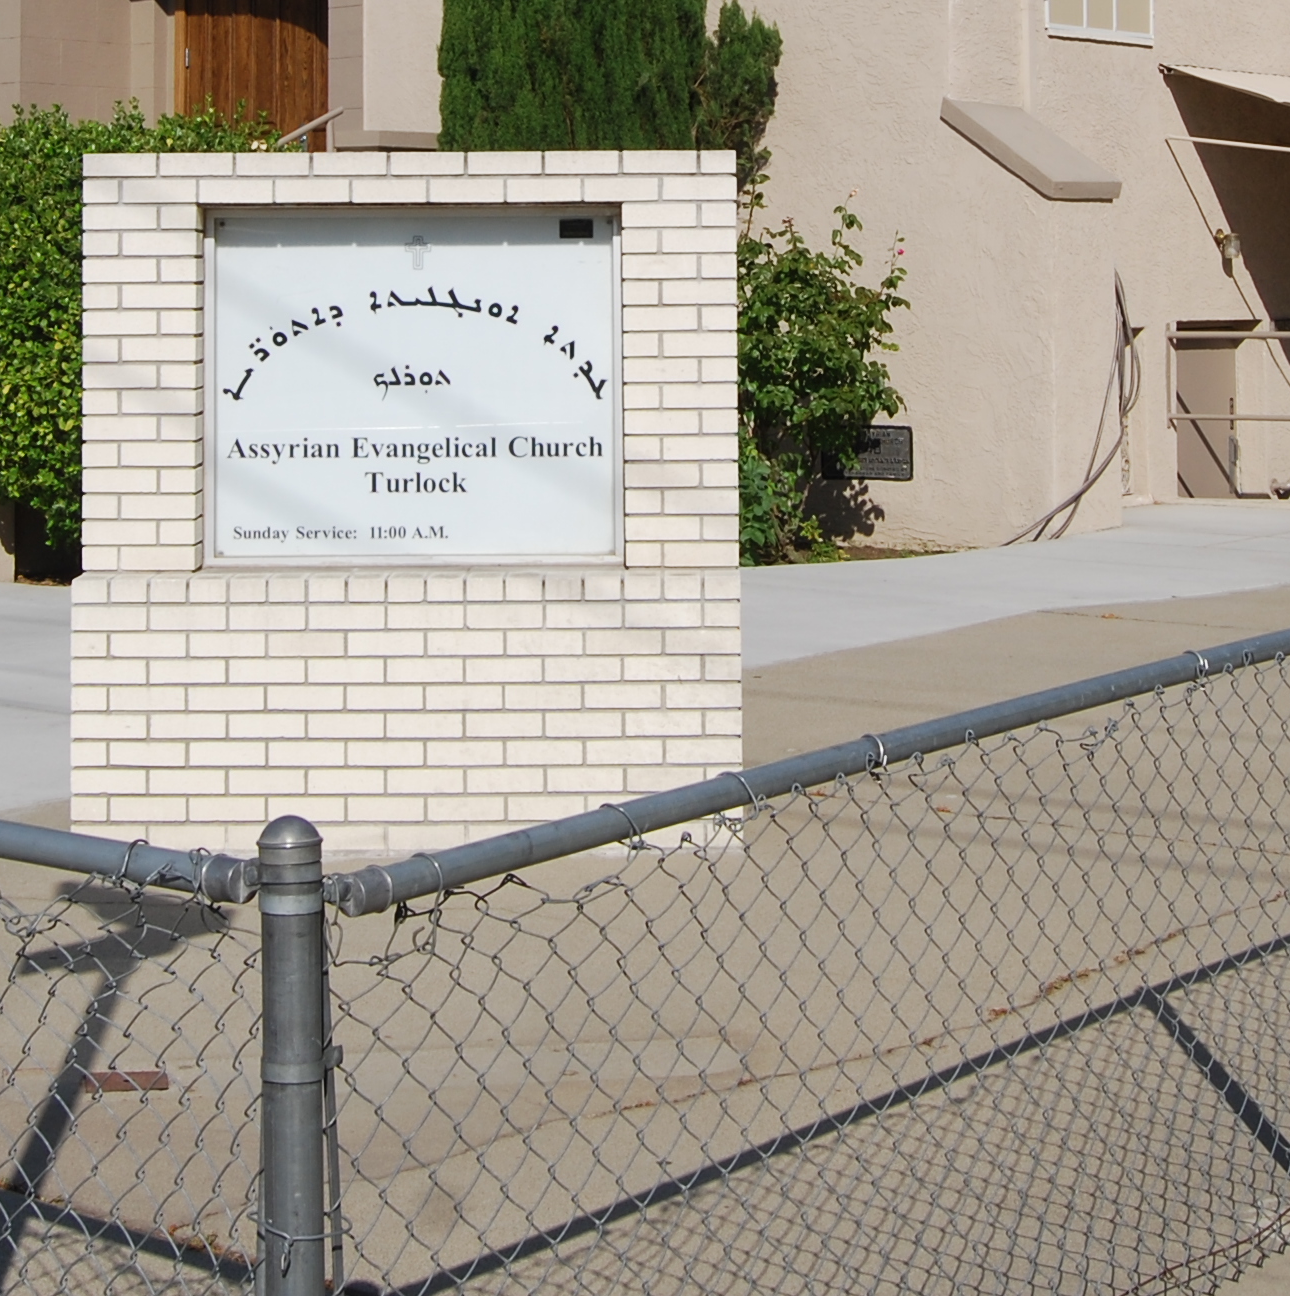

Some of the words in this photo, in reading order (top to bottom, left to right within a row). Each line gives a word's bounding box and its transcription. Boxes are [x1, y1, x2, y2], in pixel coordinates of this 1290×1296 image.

[226, 437, 341, 465] Assyrian
[352, 436, 497, 465] Evangelical
[508, 435, 603, 459] Church
[364, 471, 468, 494] Turlock
[233, 526, 289, 542] Sunday
[295, 525, 358, 540] Service:
[369, 526, 407, 540] 11:00
[412, 525, 449, 540] A.M.
